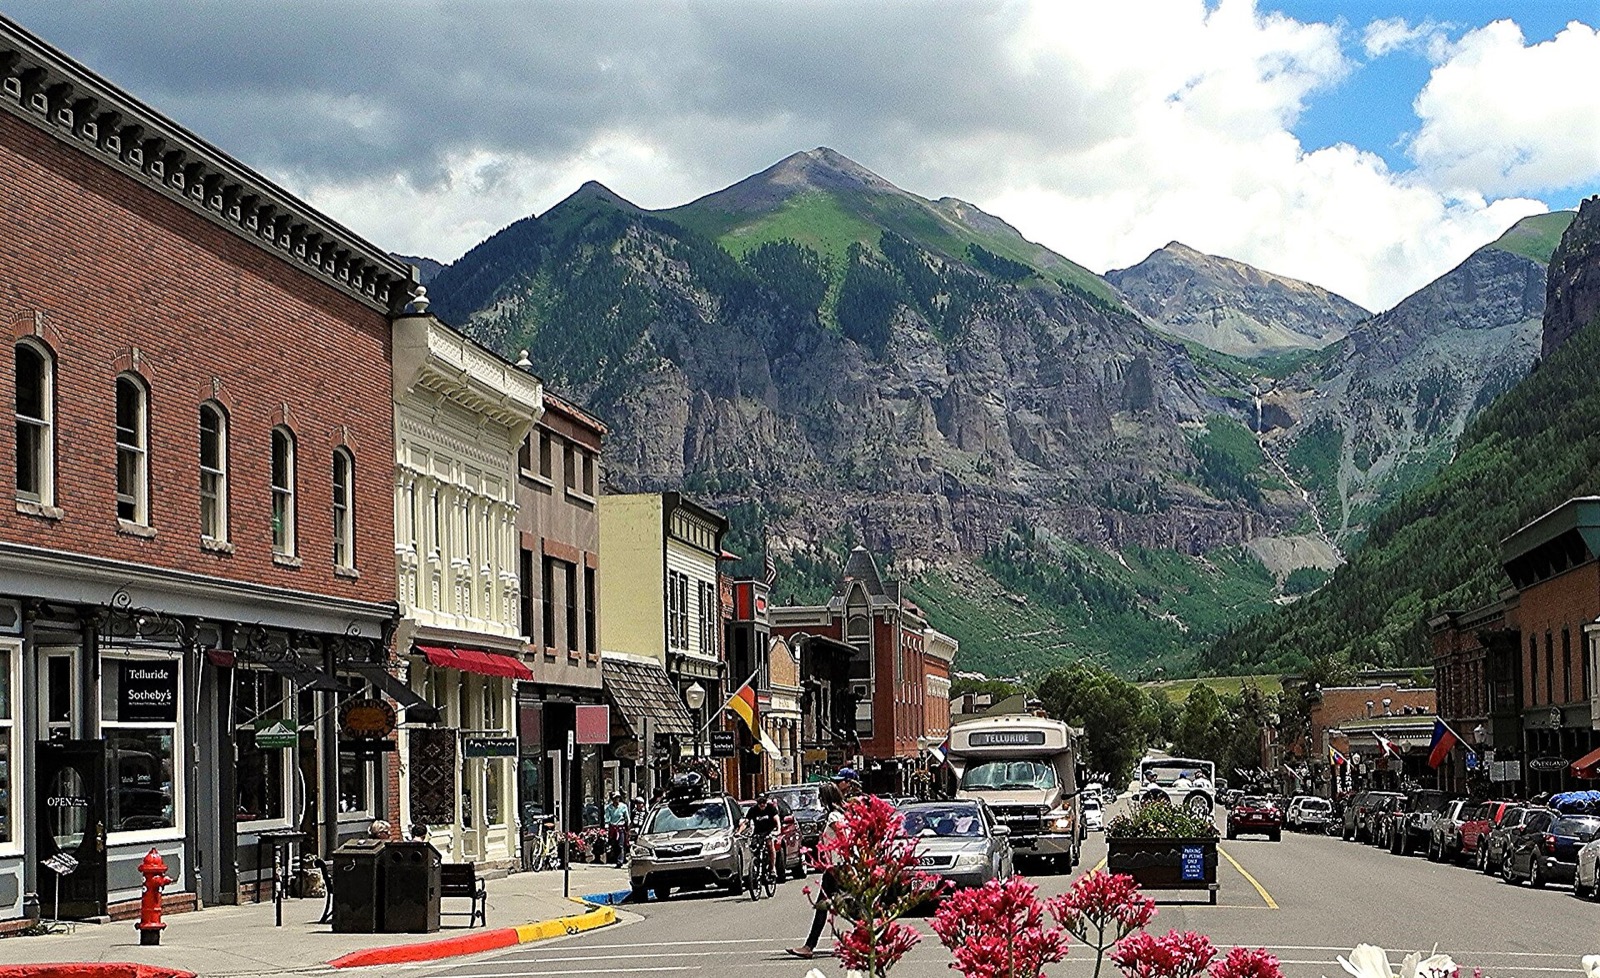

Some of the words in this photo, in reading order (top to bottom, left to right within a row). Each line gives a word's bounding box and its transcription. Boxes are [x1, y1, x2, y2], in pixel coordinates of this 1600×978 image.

[128, 669, 169, 679] Telluride
[128, 689, 172, 702] Sotheby's
[985, 734, 1029, 743] TELLURIDE
[47, 796, 72, 807] OPEN
